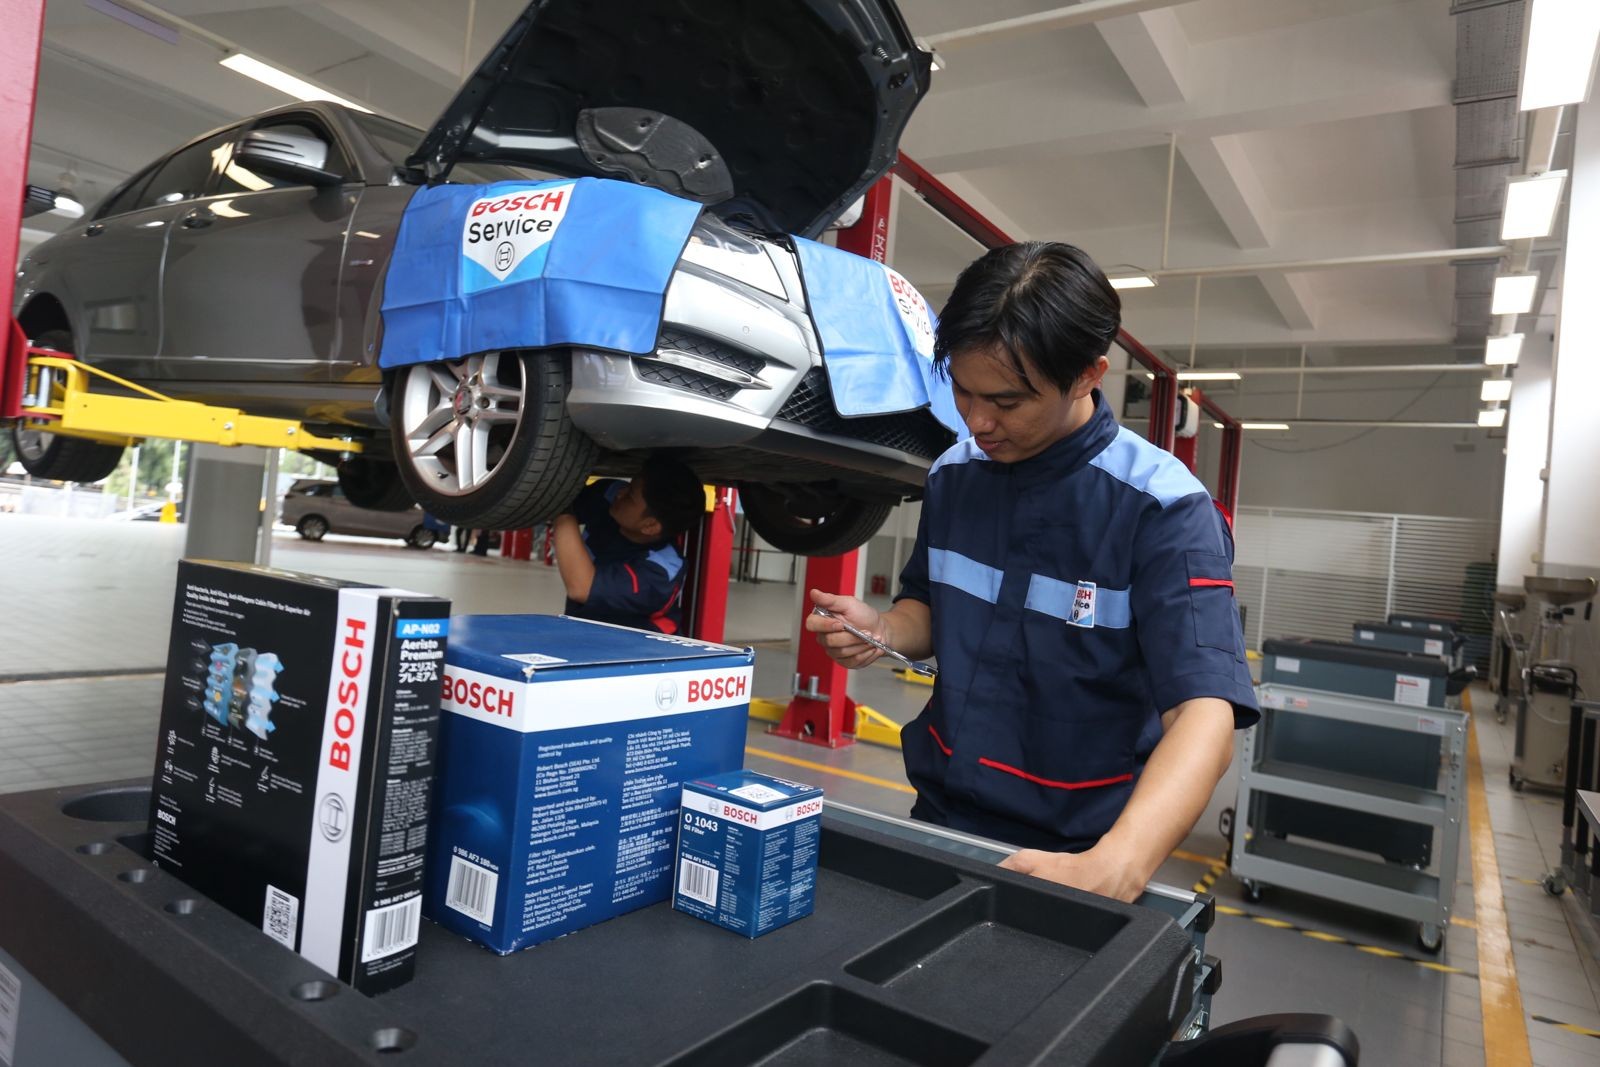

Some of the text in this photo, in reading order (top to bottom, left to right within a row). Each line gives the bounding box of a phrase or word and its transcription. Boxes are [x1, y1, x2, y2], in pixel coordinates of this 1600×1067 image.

[471, 191, 564, 217] BOSCH
[468, 213, 552, 244] Service
[402, 624, 440, 634] AP-N02
[401, 639, 438, 650] Aeristo
[400, 650, 443, 660] Premium
[399, 661, 438, 673] アエリスト
[398, 671, 438, 683] プレミアム
[329, 618, 366, 772] BOSCH
[442, 674, 514, 718] BOSCH
[688, 674, 747, 703] BOSCH
[724, 806, 757, 824] BOSCH
[797, 800, 820, 816] BOSCH
[158, 809, 176, 826] BOSCH
[695, 816, 718, 832] 1043
[692, 826, 704, 835] Filter
[468, 853, 479, 862] AF2
